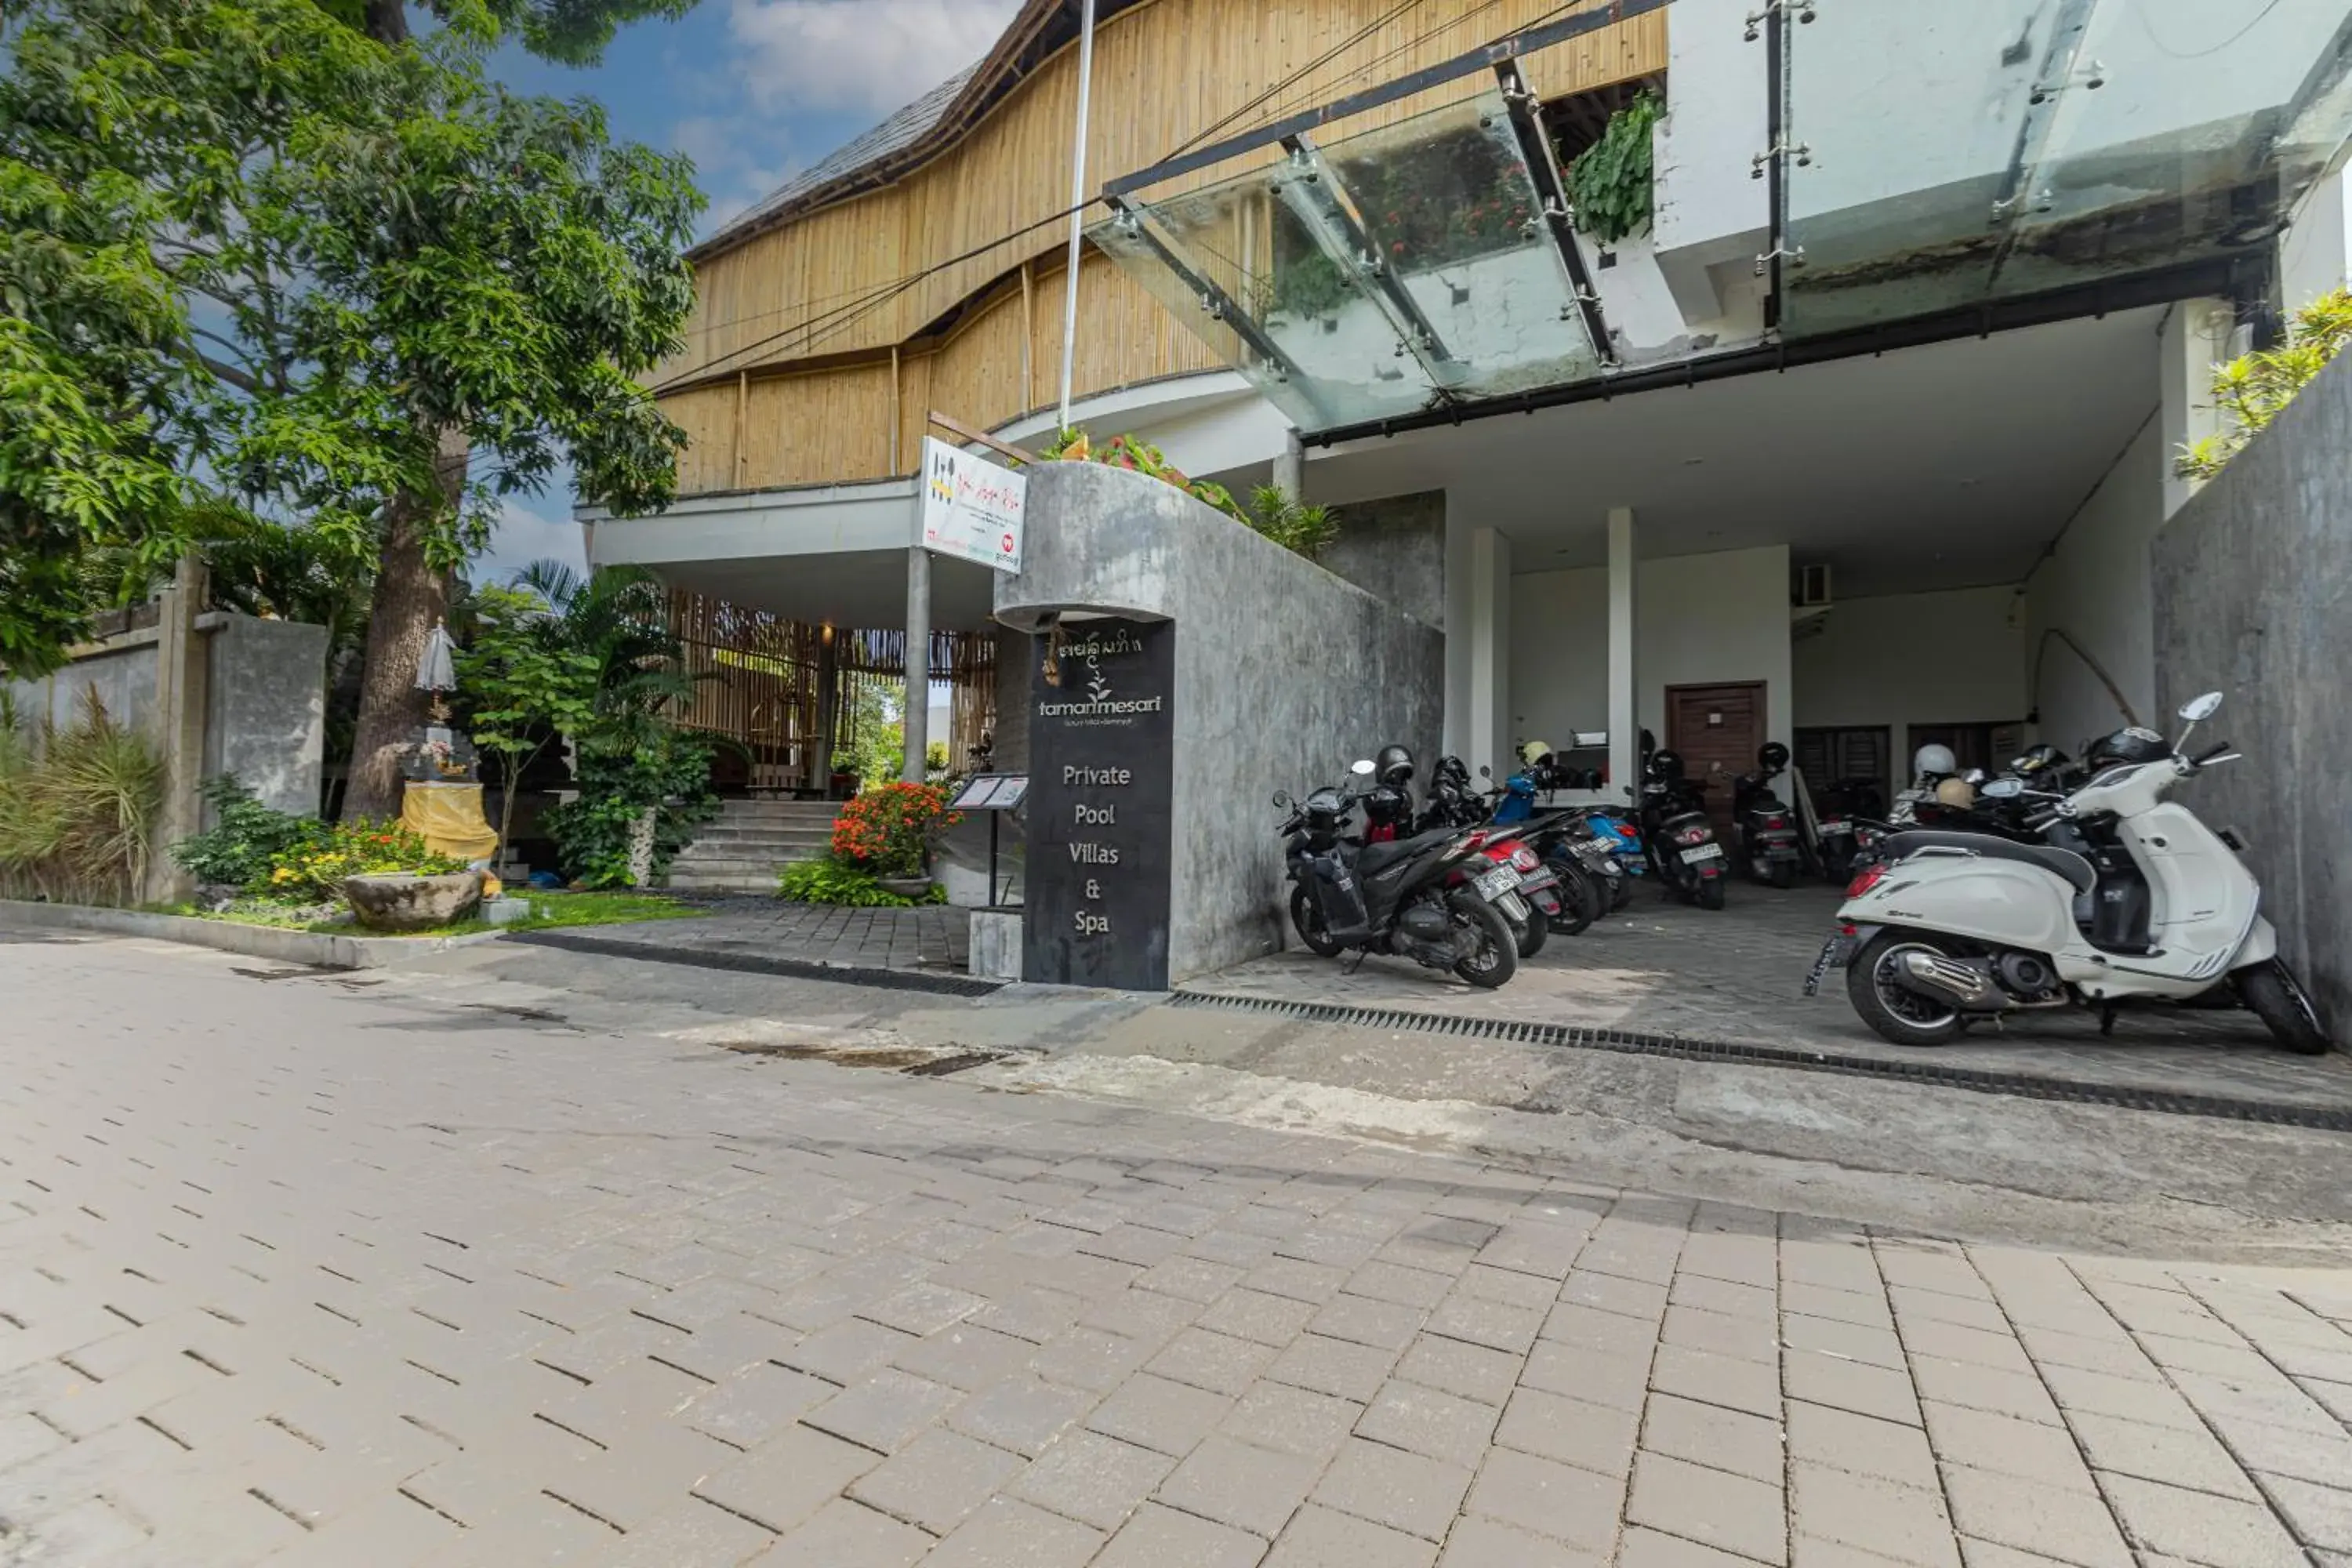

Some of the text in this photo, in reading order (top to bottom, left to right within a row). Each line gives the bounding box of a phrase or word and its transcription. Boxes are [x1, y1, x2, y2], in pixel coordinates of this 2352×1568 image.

[1063, 765, 1131, 785] Private
[1075, 804, 1116, 824] Pool
[1069, 843, 1120, 864] Villas
[1086, 879, 1101, 899] &
[1075, 910, 1109, 935] Spa
